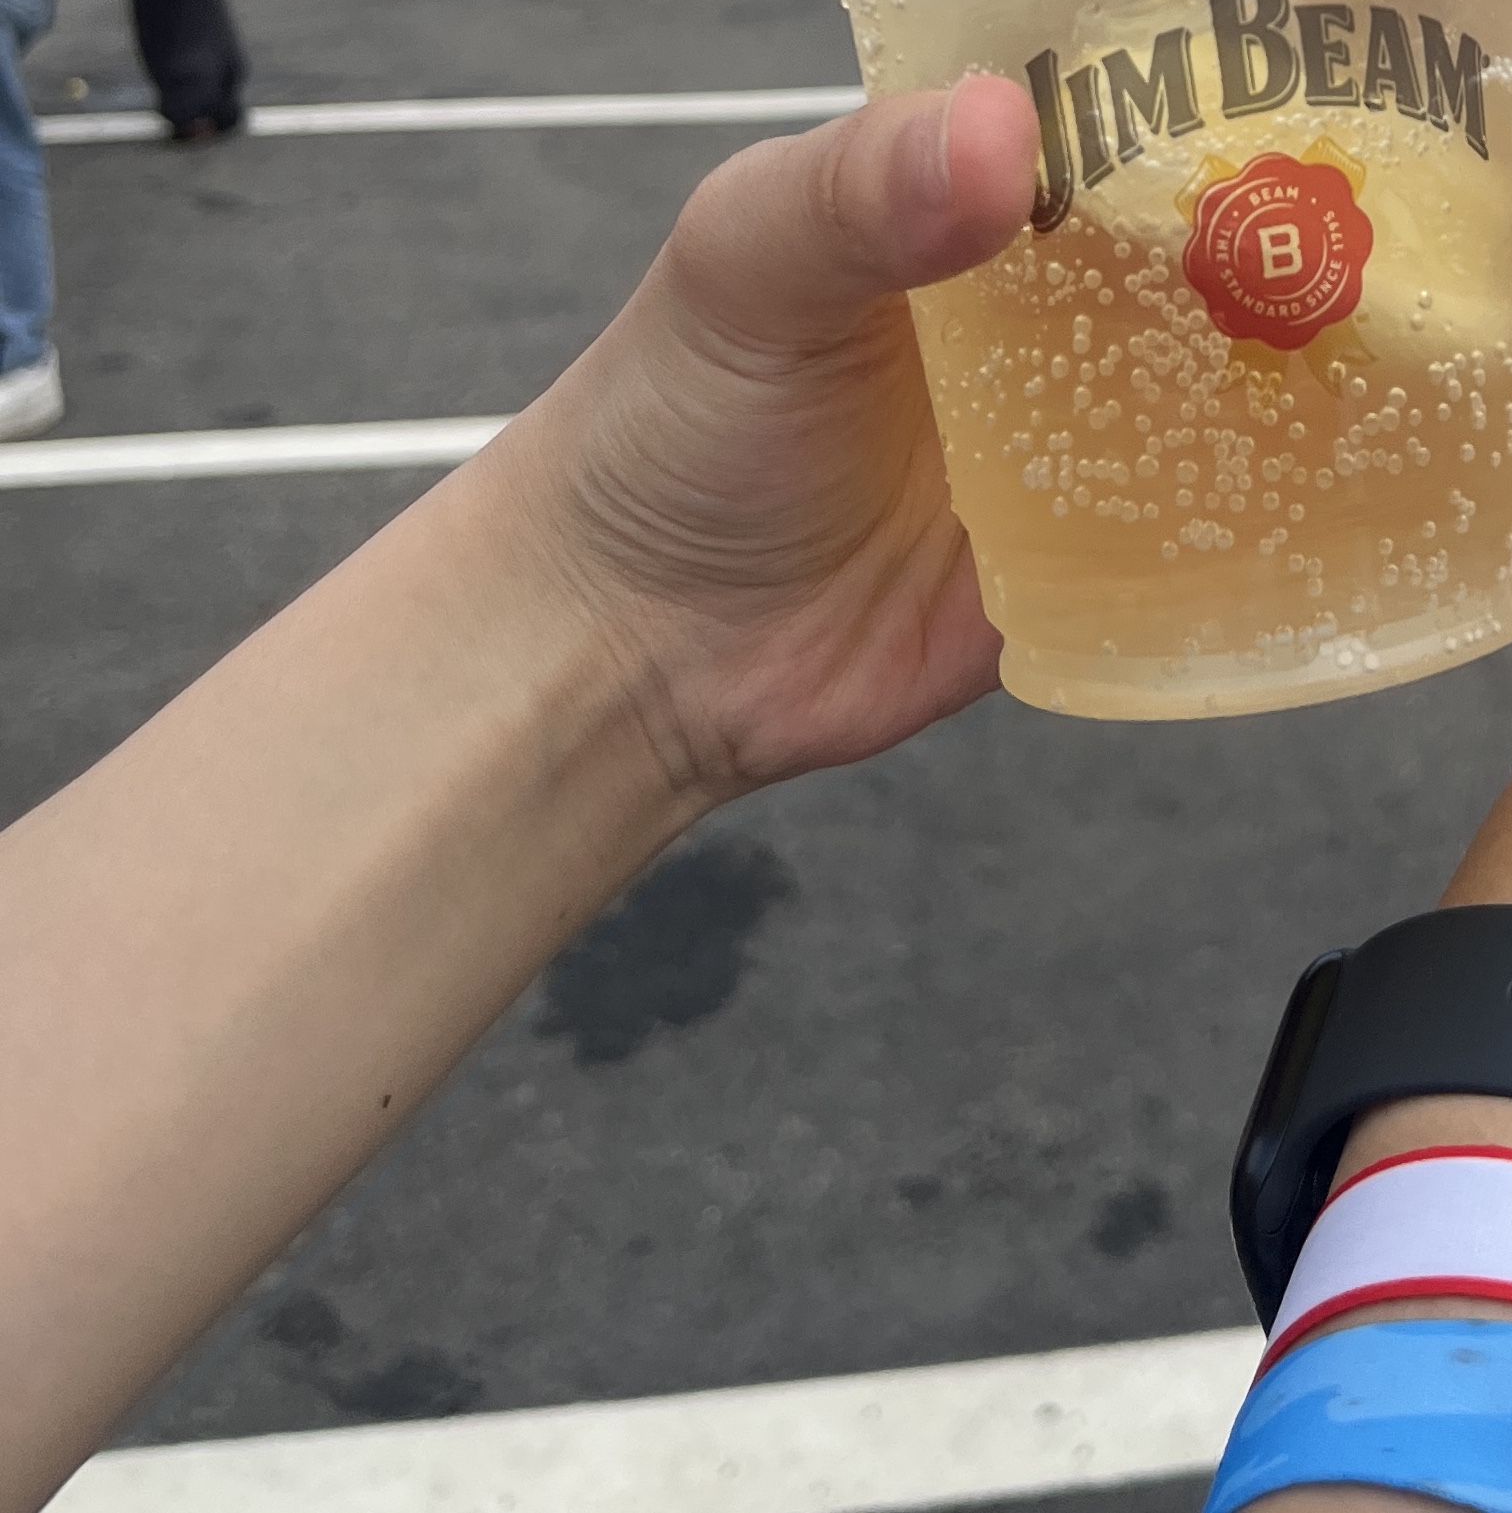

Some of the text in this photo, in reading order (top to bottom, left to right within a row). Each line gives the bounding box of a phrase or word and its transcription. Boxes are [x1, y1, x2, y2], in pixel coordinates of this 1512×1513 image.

[1025, 26, 1205, 233] JIM
[1248, 186, 1300, 207] BEAM
[1216, 228, 1233, 263] THE
[1257, 223, 1304, 280] B
[1219, 268, 1301, 318] STANDARD
[1305, 260, 1343, 307] SINCE
